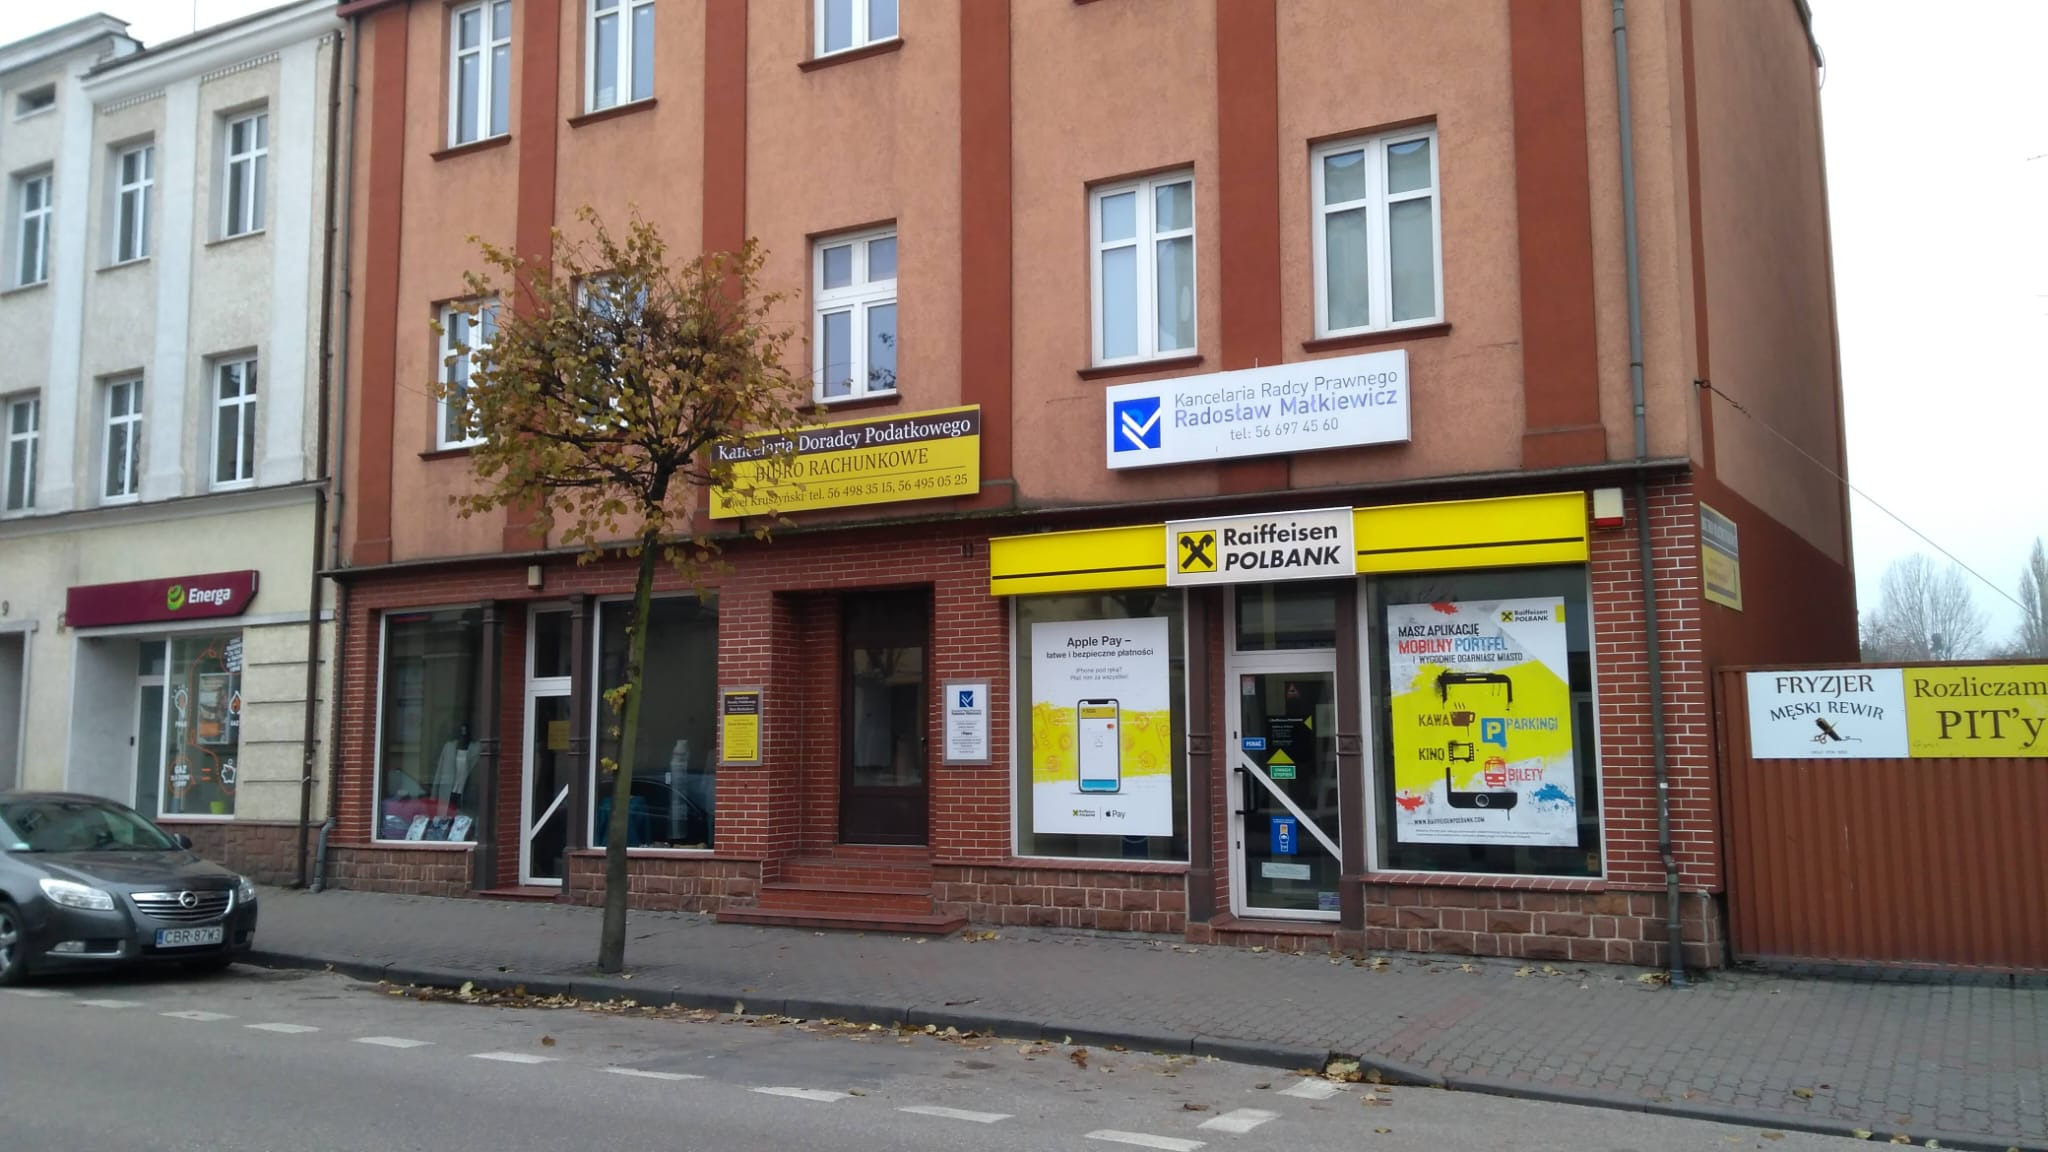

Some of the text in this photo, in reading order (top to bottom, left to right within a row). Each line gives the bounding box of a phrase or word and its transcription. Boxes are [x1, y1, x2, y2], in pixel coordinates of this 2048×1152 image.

[1175, 371, 1398, 408] Kancelaria Radcy Prawnego
[1175, 387, 1398, 428] Radosław Małkiewicz
[799, 430, 861, 450] Doradcy
[864, 419, 971, 443] Podatkowego
[1230, 416, 1339, 441] tel: 56 697 45 60
[756, 448, 929, 482] BIURO RACHUNKOWE
[809, 486, 825, 501] tel.
[827, 483, 841, 499] 56
[843, 484, 864, 497] 498
[865, 482, 879, 495] 35
[881, 480, 896, 493] 15,
[898, 478, 912, 492] 56
[914, 476, 935, 489] 495
[937, 475, 952, 488] 05
[954, 473, 968, 486] 25
[1223, 522, 1338, 547] Raiffeisen
[1225, 545, 1341, 571] POLBANK
[188, 588, 231, 606] Energa
[1398, 626, 1425, 637] MASZ
[1066, 637, 1098, 649] Apple
[1101, 635, 1122, 648] Pay
[1398, 636, 1509, 654] MOBILNY PORTFEL
[1072, 650, 1116, 659] bezpieczne
[1776, 674, 1875, 699] FRYZJER
[1913, 676, 2048, 698] Rozliczam
[1418, 714, 1450, 727] KAWA
[1770, 701, 1885, 722] MĘSKI REWIR
[1507, 717, 1558, 731] PARKINGI
[1418, 747, 1445, 761] KINO
[1508, 767, 1544, 781] BILETY
[1112, 809, 1126, 819] Pay
[165, 930, 190, 944] CBR
